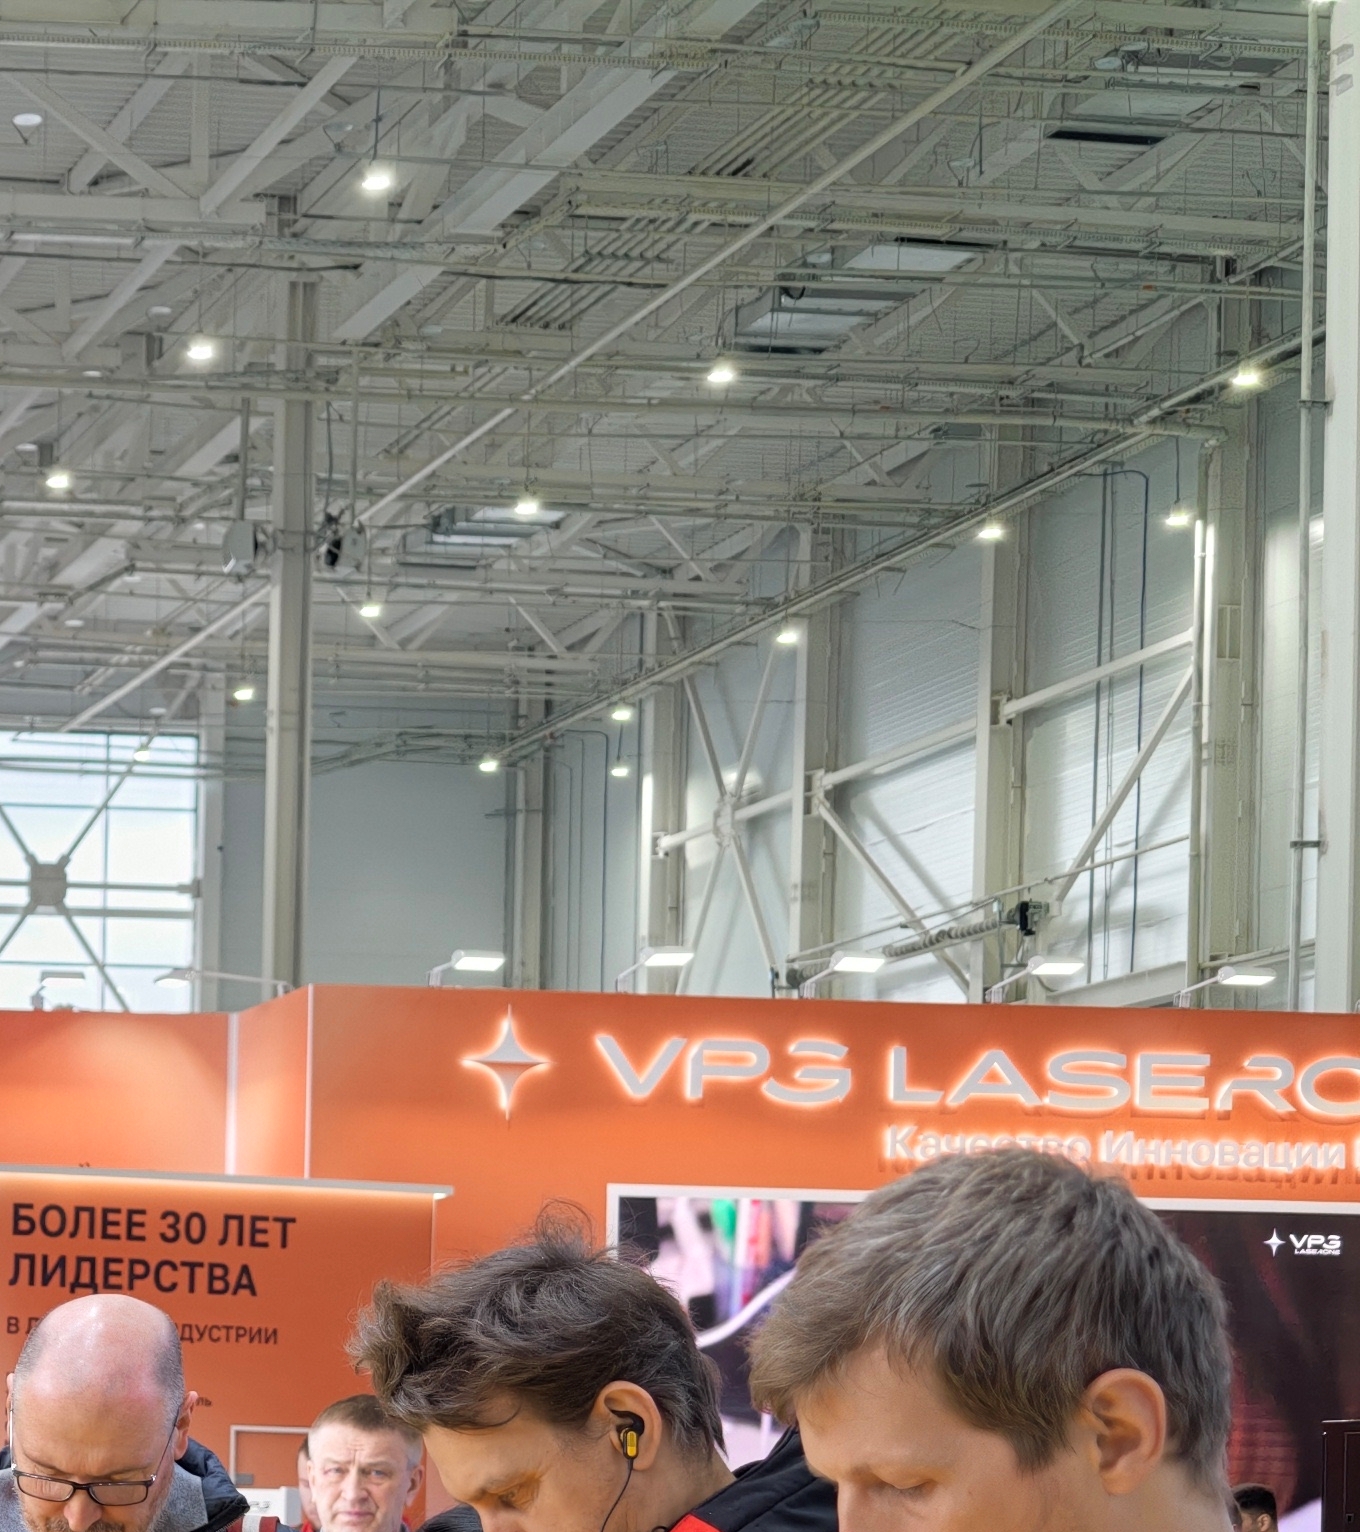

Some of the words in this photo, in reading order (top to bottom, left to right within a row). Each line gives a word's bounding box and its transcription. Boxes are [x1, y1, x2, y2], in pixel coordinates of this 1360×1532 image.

[1104, 1129, 1346, 1173] Инновации
[12, 1202, 147, 1242] БОЛЕЕ
[159, 1210, 207, 1245] 30
[218, 1213, 297, 1249] ЛЕТ
[8, 1253, 258, 1297] ЛИДЕРСТВА
[6, 1316, 19, 1335] В
[174, 1322, 278, 1345] ДУСТРИИ
